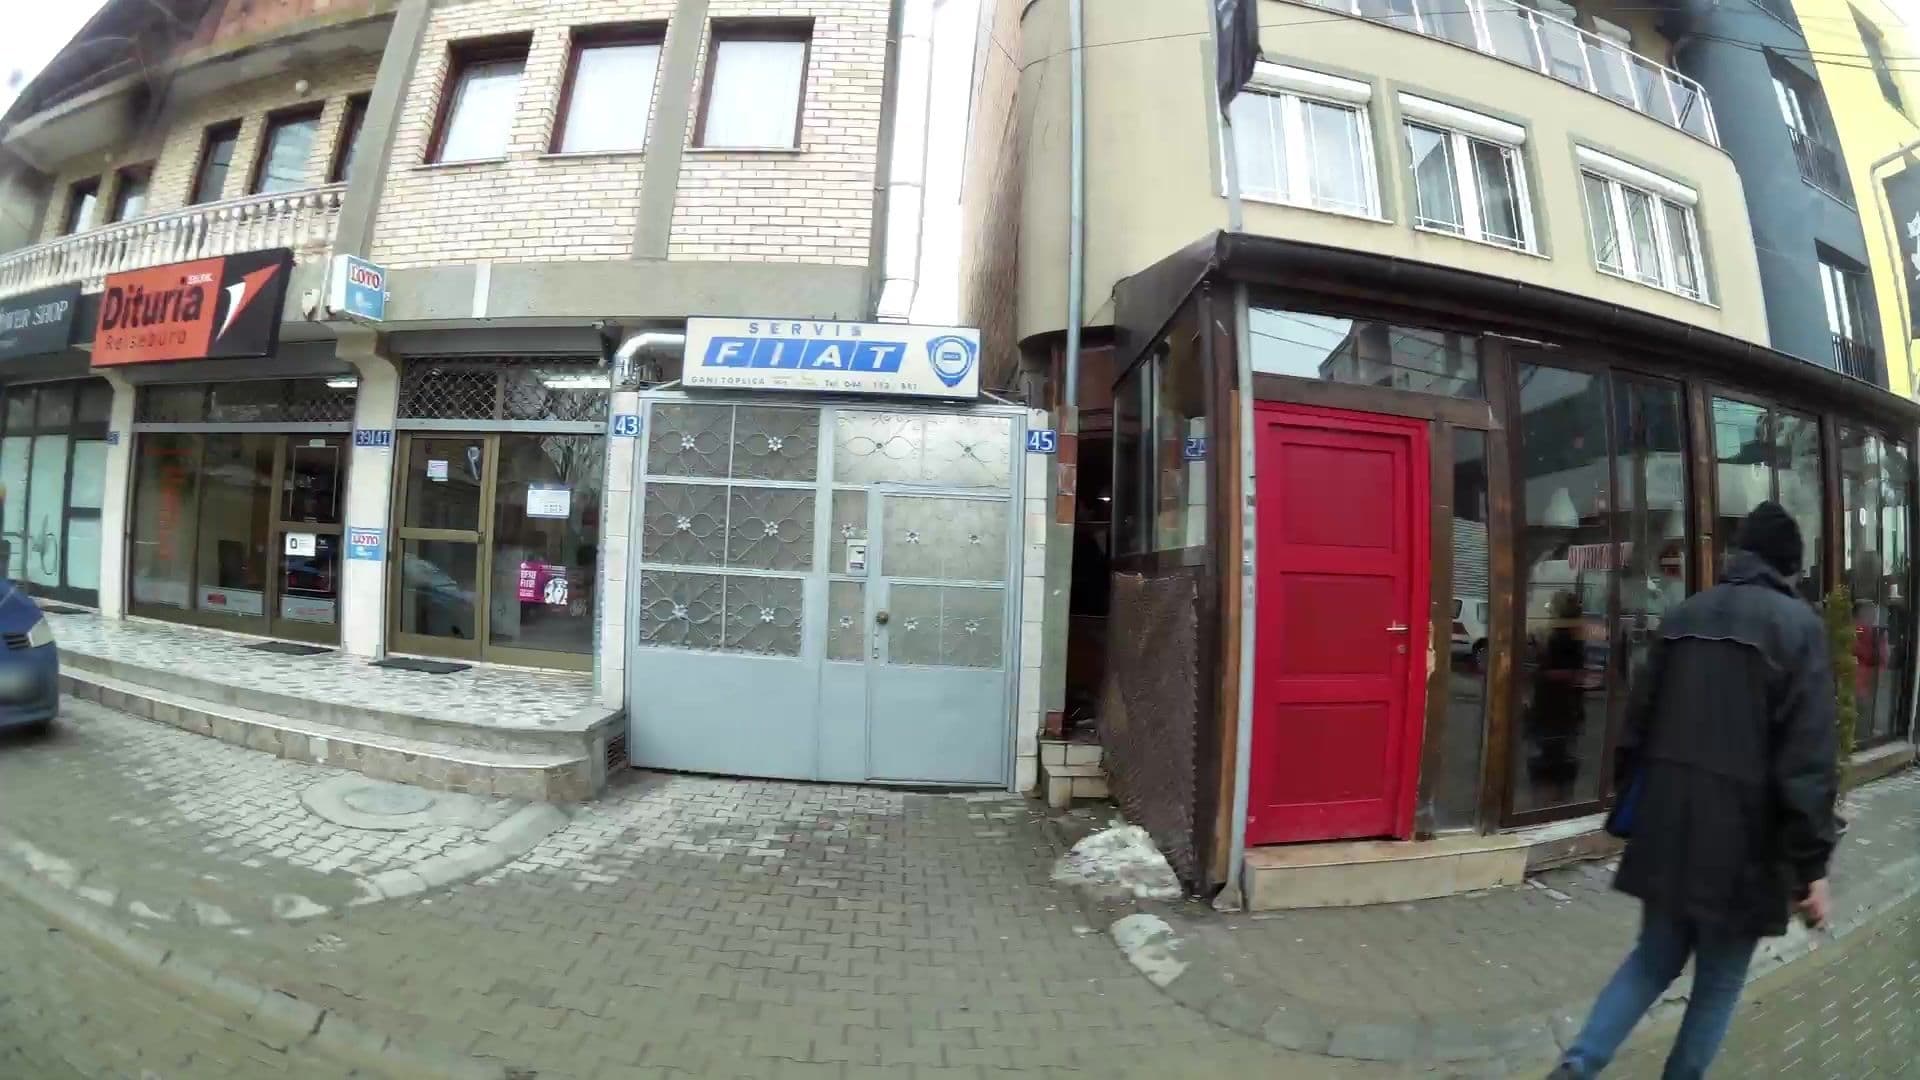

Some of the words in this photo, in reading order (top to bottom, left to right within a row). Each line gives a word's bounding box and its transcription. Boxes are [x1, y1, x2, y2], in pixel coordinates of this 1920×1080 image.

[351, 264, 381, 289] LOTO
[102, 276, 206, 331] Dituria
[748, 322, 862, 337] SERVIS
[714, 341, 897, 369] FIAT
[615, 415, 638, 435] 43
[1029, 431, 1053, 450] 45
